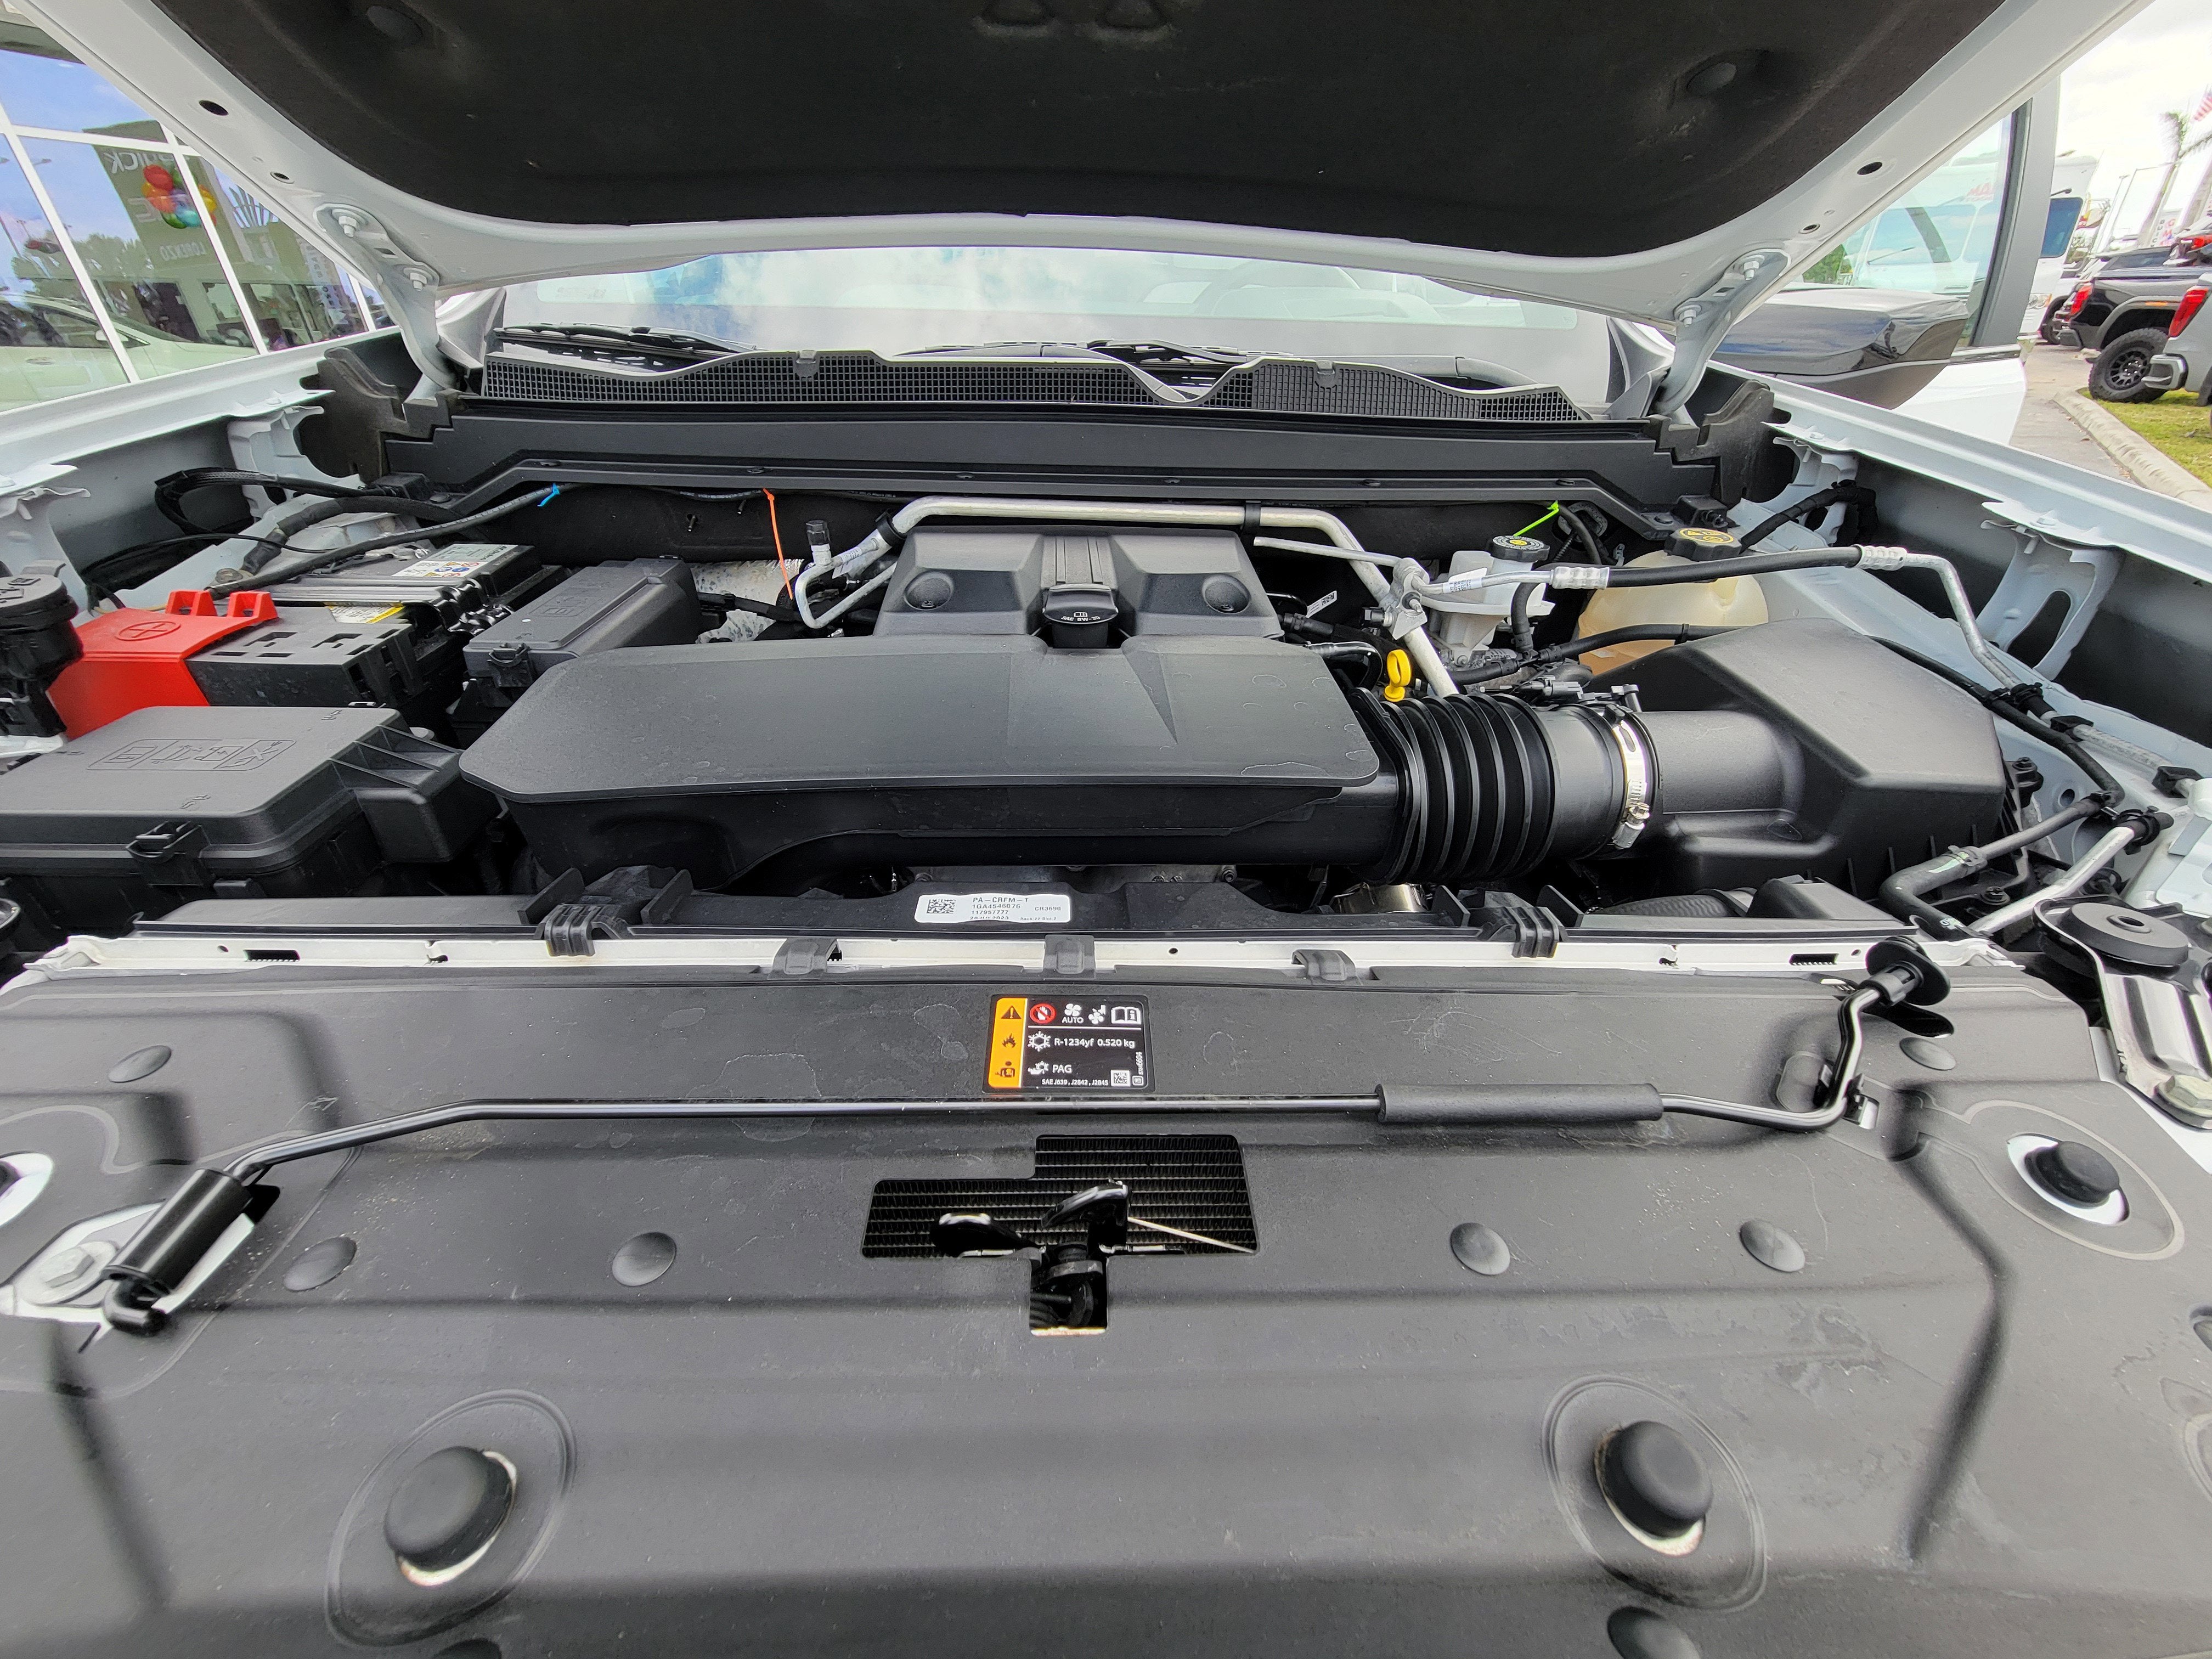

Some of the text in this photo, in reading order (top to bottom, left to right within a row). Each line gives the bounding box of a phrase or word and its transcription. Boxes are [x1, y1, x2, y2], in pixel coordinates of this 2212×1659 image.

[1054, 1038, 1136, 1049] R-1234yf 0.520 kg
[1052, 1064, 1072, 1074] PAG
